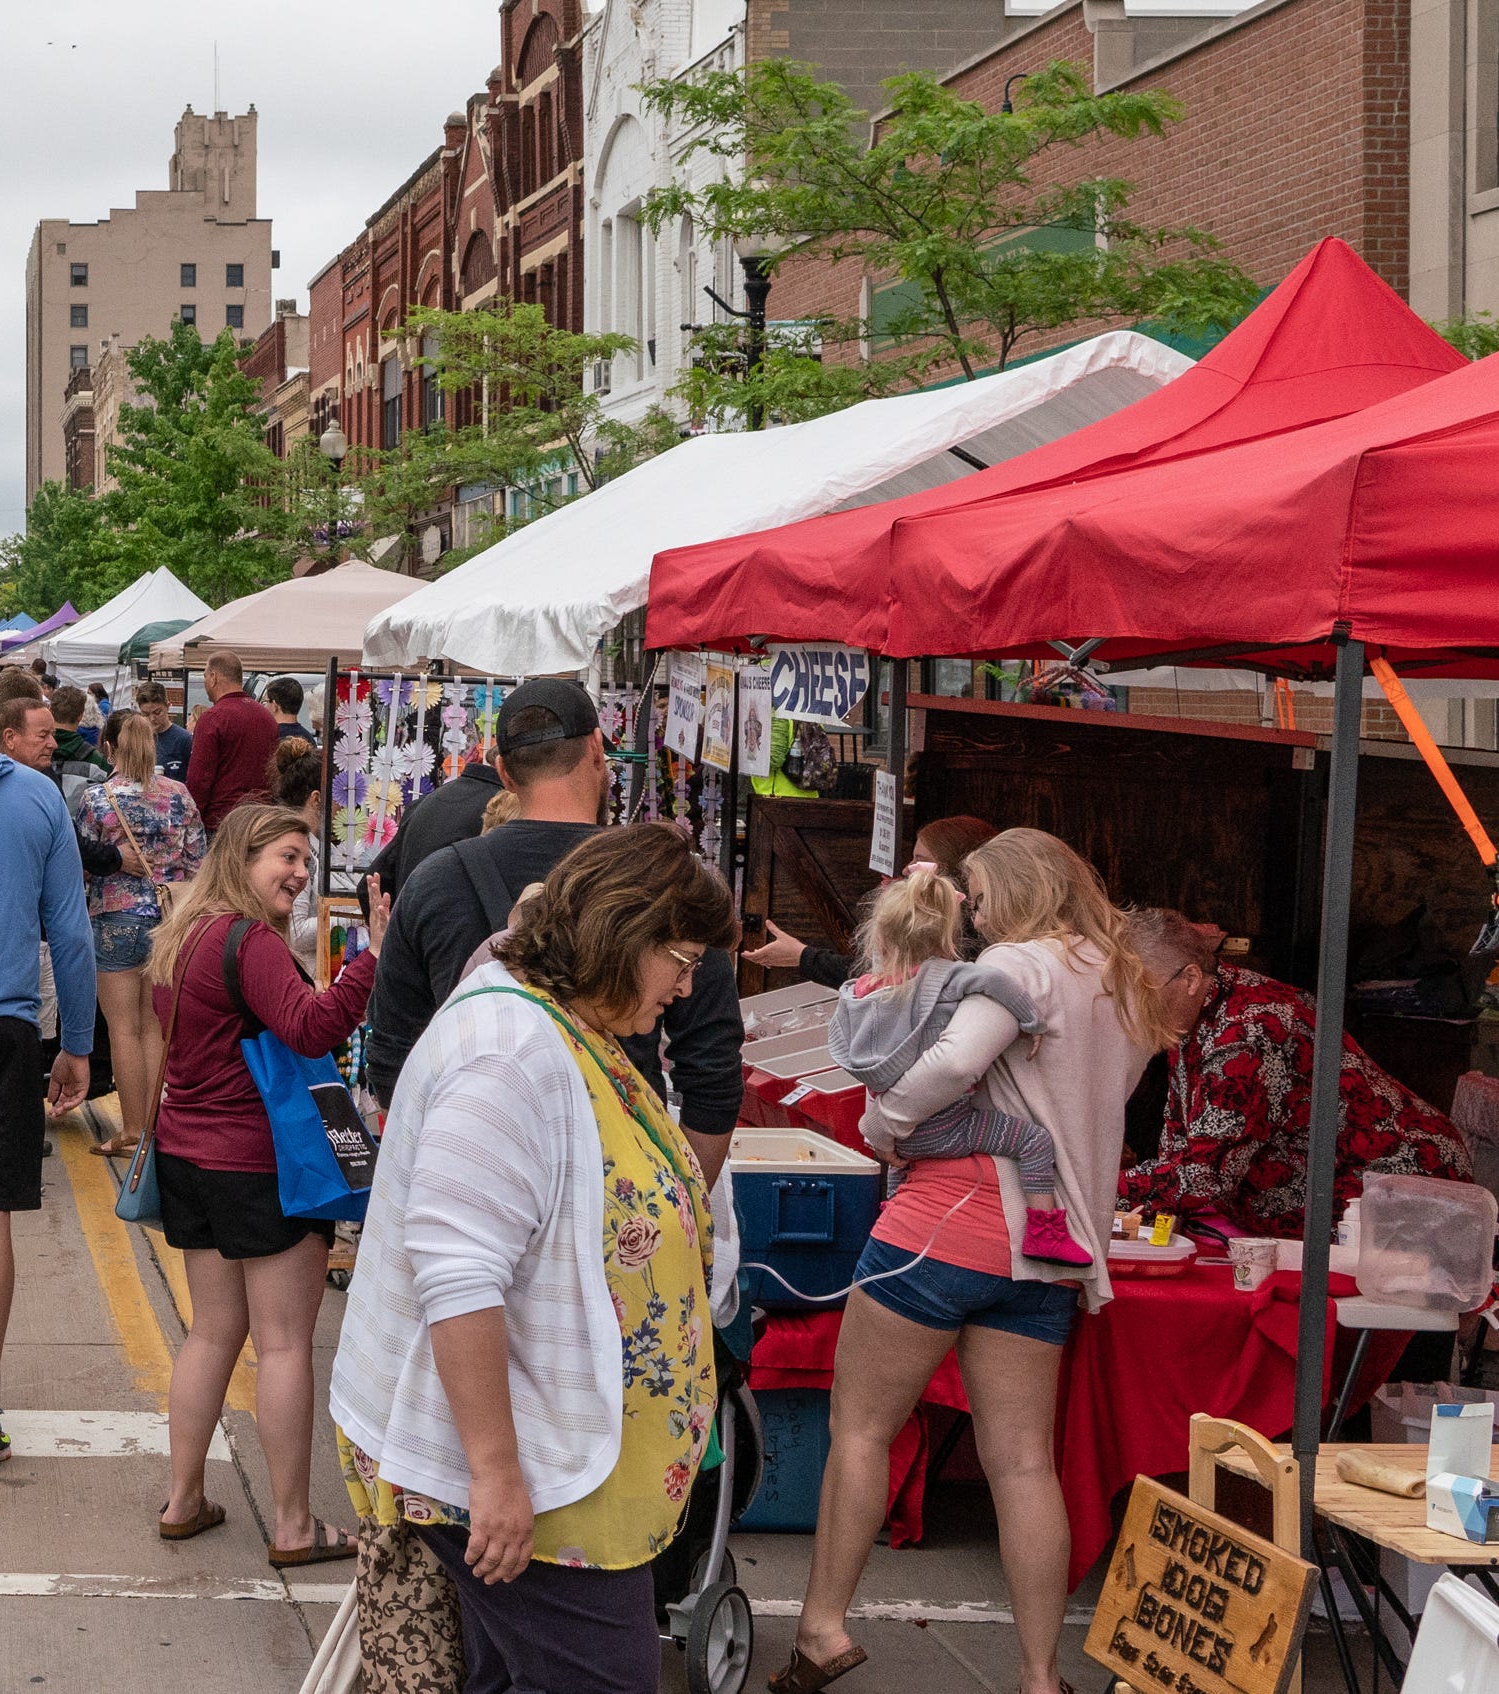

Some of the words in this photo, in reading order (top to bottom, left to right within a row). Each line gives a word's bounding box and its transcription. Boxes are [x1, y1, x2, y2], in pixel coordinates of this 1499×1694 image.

[1151, 1505, 1266, 1596] SMOKED
[1161, 1557, 1229, 1623] DOG
[1136, 1591, 1234, 1676] BONES
